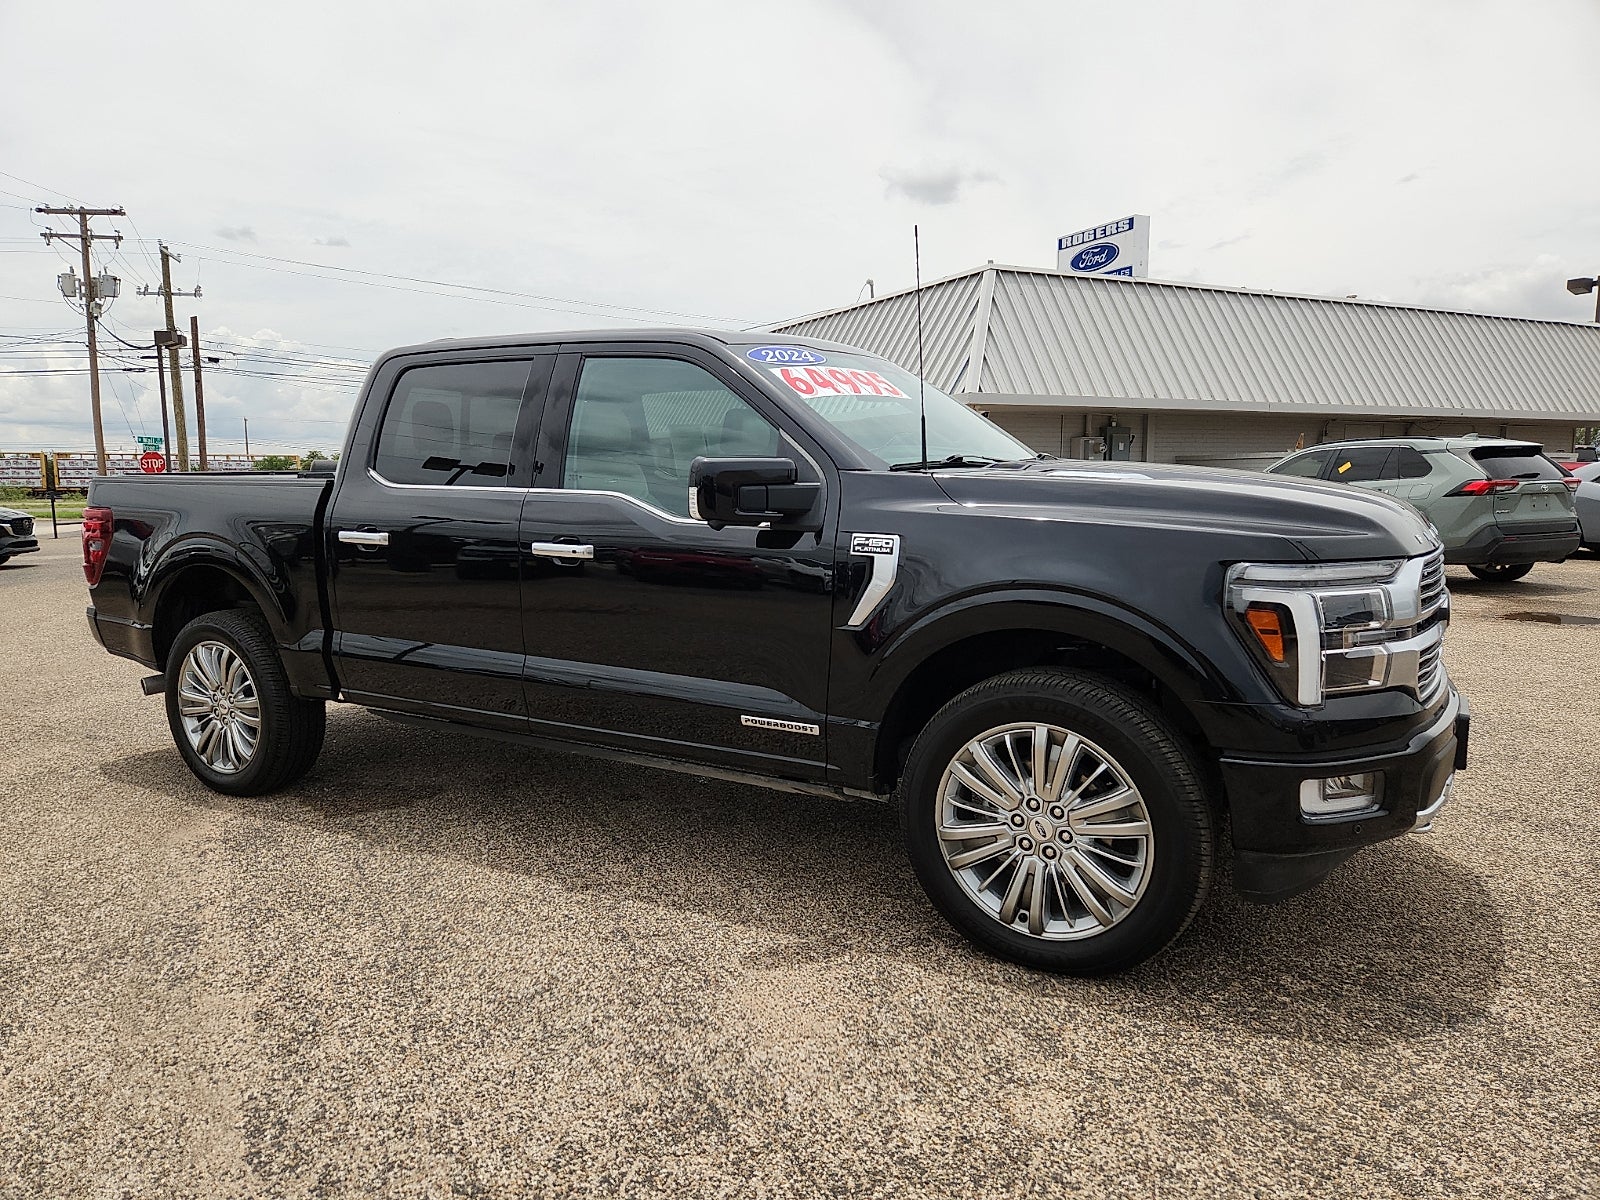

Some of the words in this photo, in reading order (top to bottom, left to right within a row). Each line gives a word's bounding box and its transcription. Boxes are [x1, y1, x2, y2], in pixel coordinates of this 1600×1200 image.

[1061, 219, 1130, 249] ROGERS
[1079, 247, 1108, 269] Ford
[761, 350, 816, 362] 2024
[780, 368, 902, 397] 64995
[142, 458, 164, 468] STOP
[853, 537, 893, 547] F-150
[744, 717, 815, 733] POWERBOOST
